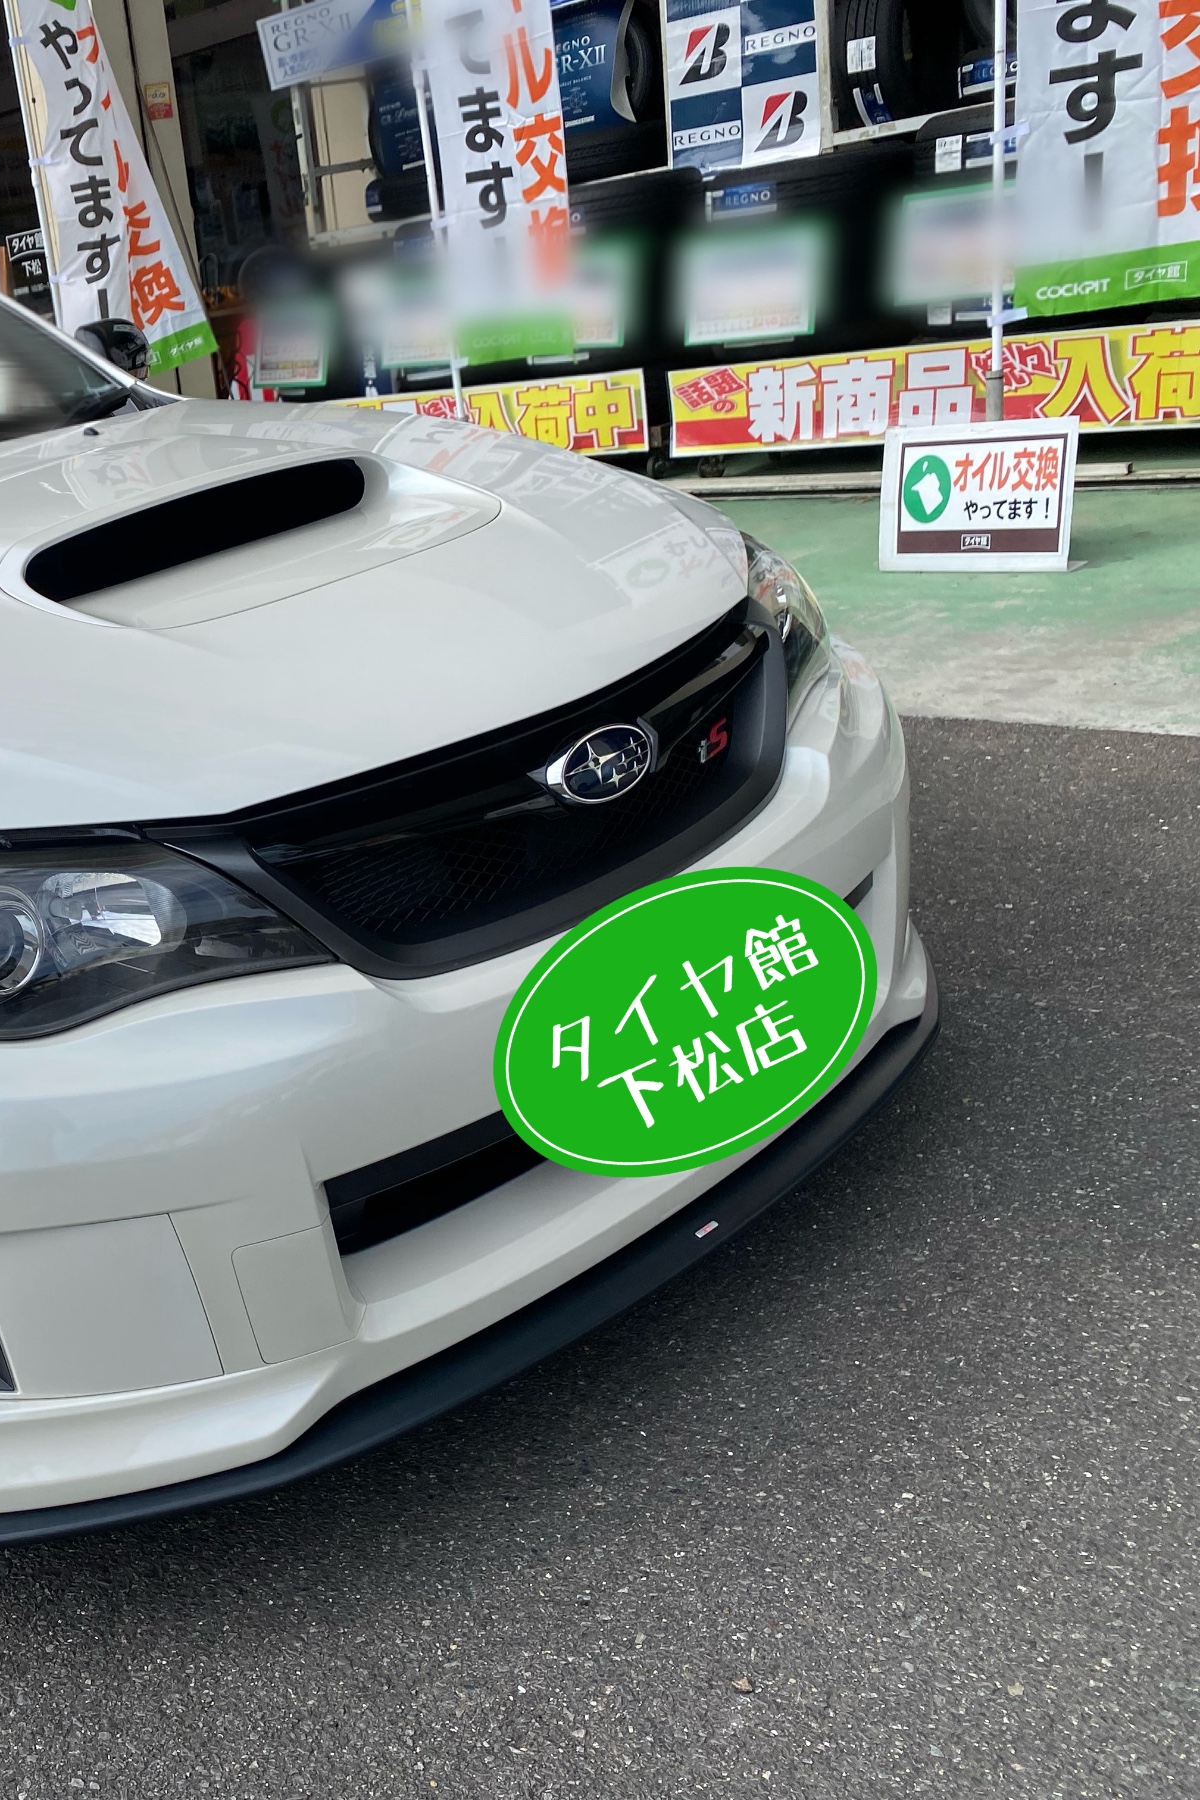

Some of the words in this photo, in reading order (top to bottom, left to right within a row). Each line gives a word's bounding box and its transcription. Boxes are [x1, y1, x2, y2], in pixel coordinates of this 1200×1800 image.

[271, 8, 330, 34] REGNO
[555, 35, 591, 54] EGNO
[746, 25, 816, 51] REGNO
[557, 44, 607, 74] R-XII
[674, 124, 741, 147] REGNO
[725, 189, 771, 206] REGNO
[21, 258, 43, 277] 下松
[1133, 263, 1182, 284] タイヤ館
[1035, 277, 1111, 300] COCKPIT
[744, 348, 970, 443] 新商品
[953, 446, 1060, 492] オイル交換
[964, 498, 1050, 521] やってます！
